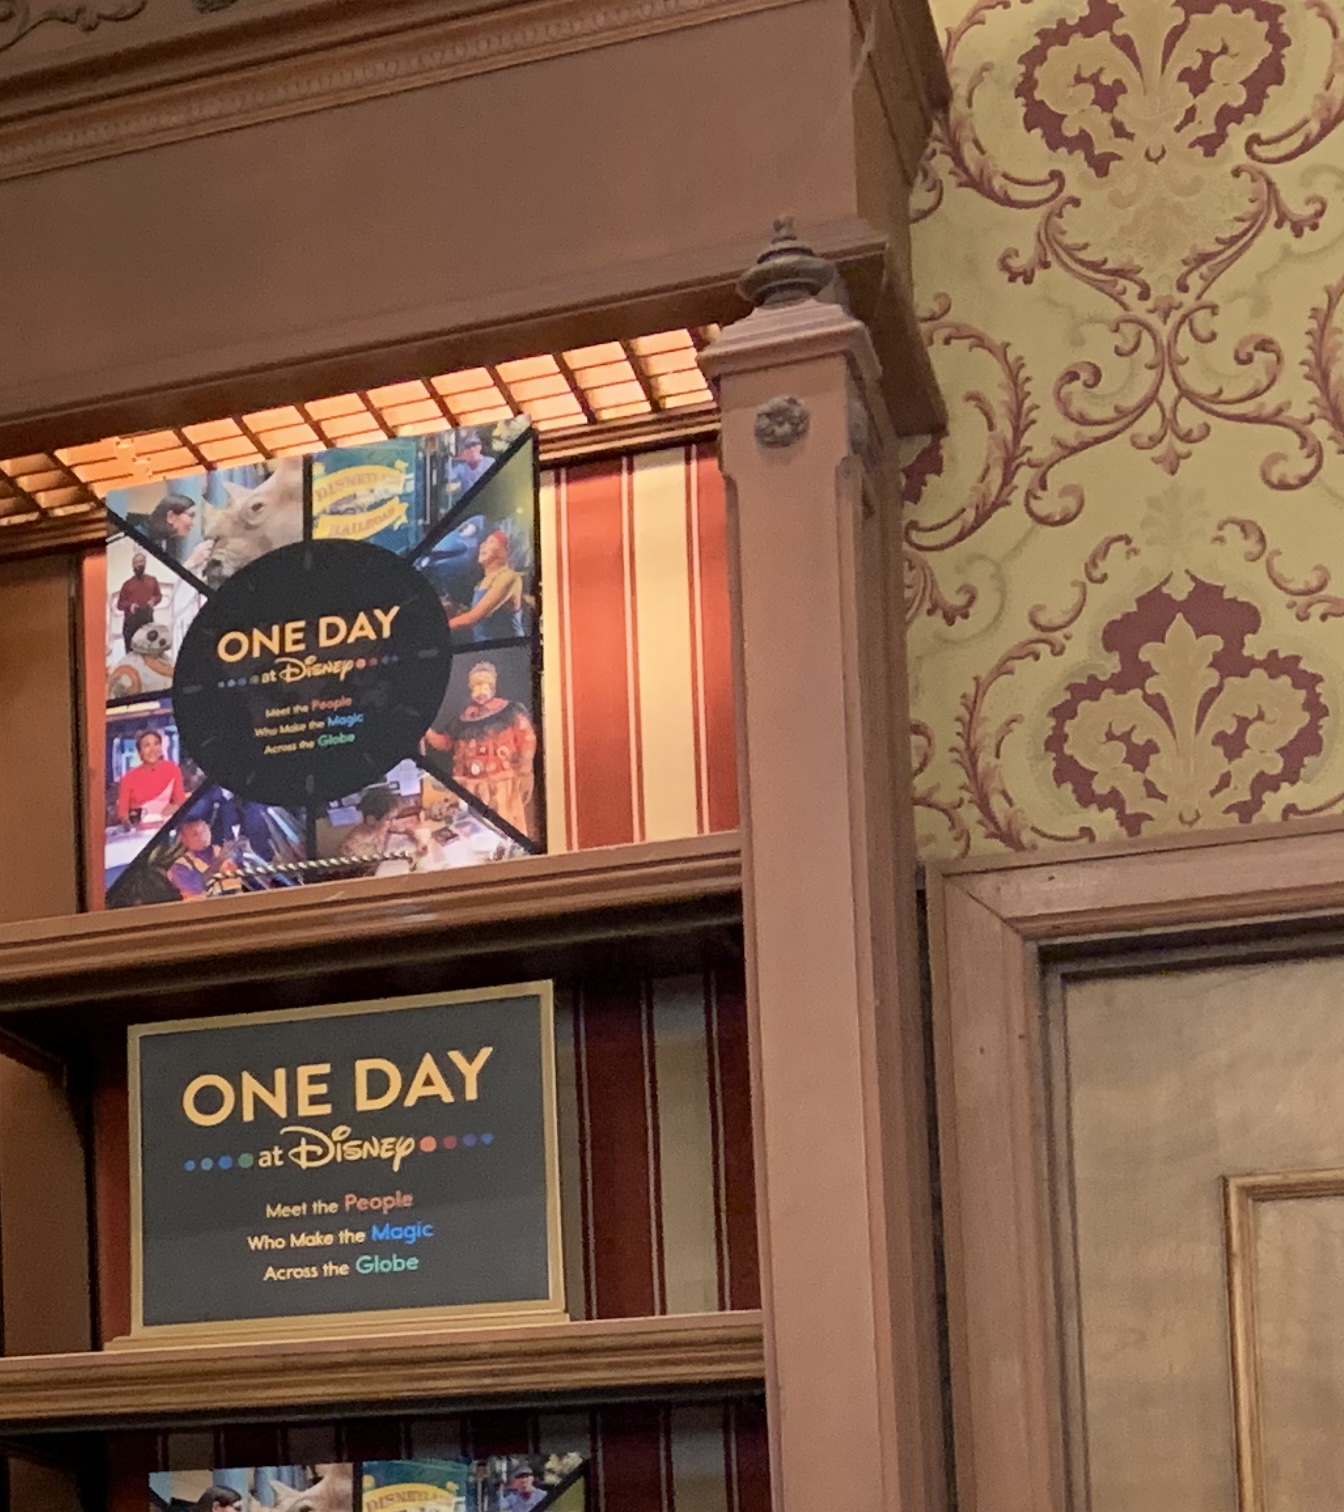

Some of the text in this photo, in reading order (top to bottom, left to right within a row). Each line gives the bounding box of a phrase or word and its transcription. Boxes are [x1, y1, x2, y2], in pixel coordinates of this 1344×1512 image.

[217, 605, 401, 663] ONE DAY
[261, 655, 354, 684] at Disney
[311, 696, 353, 712] People
[327, 713, 364, 727] Magic
[317, 732, 355, 747] Globe
[182, 1046, 494, 1127] ONE DAY
[258, 1125, 416, 1172] at Disney
[265, 1190, 414, 1218] Meet the People
[247, 1221, 434, 1250] Who Make the Magic
[263, 1253, 419, 1281] Across the Globe
